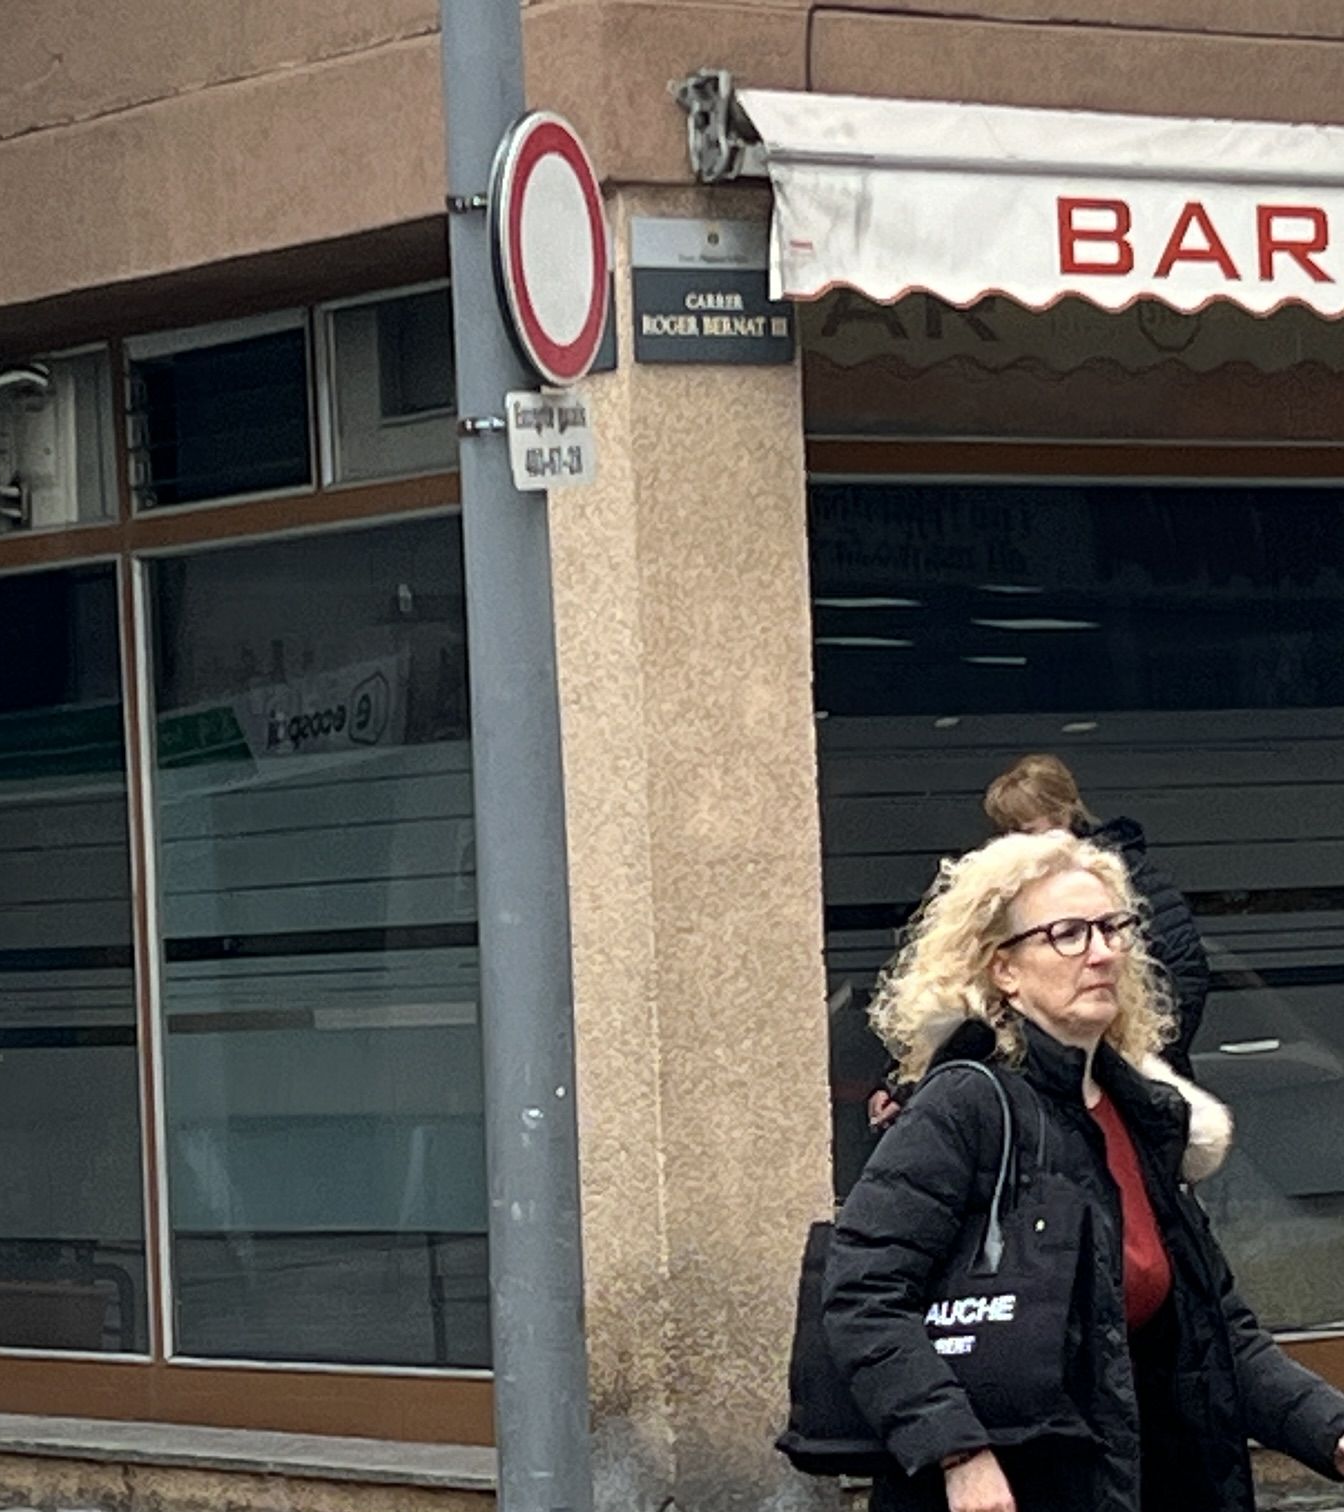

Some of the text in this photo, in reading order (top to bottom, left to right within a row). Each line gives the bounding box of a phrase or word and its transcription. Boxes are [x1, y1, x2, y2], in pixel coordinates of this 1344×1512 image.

[1057, 196, 1329, 282] BAR
[684, 292, 744, 311] CARRER
[642, 313, 700, 337] ROGER
[702, 314, 767, 337] BERNAT
